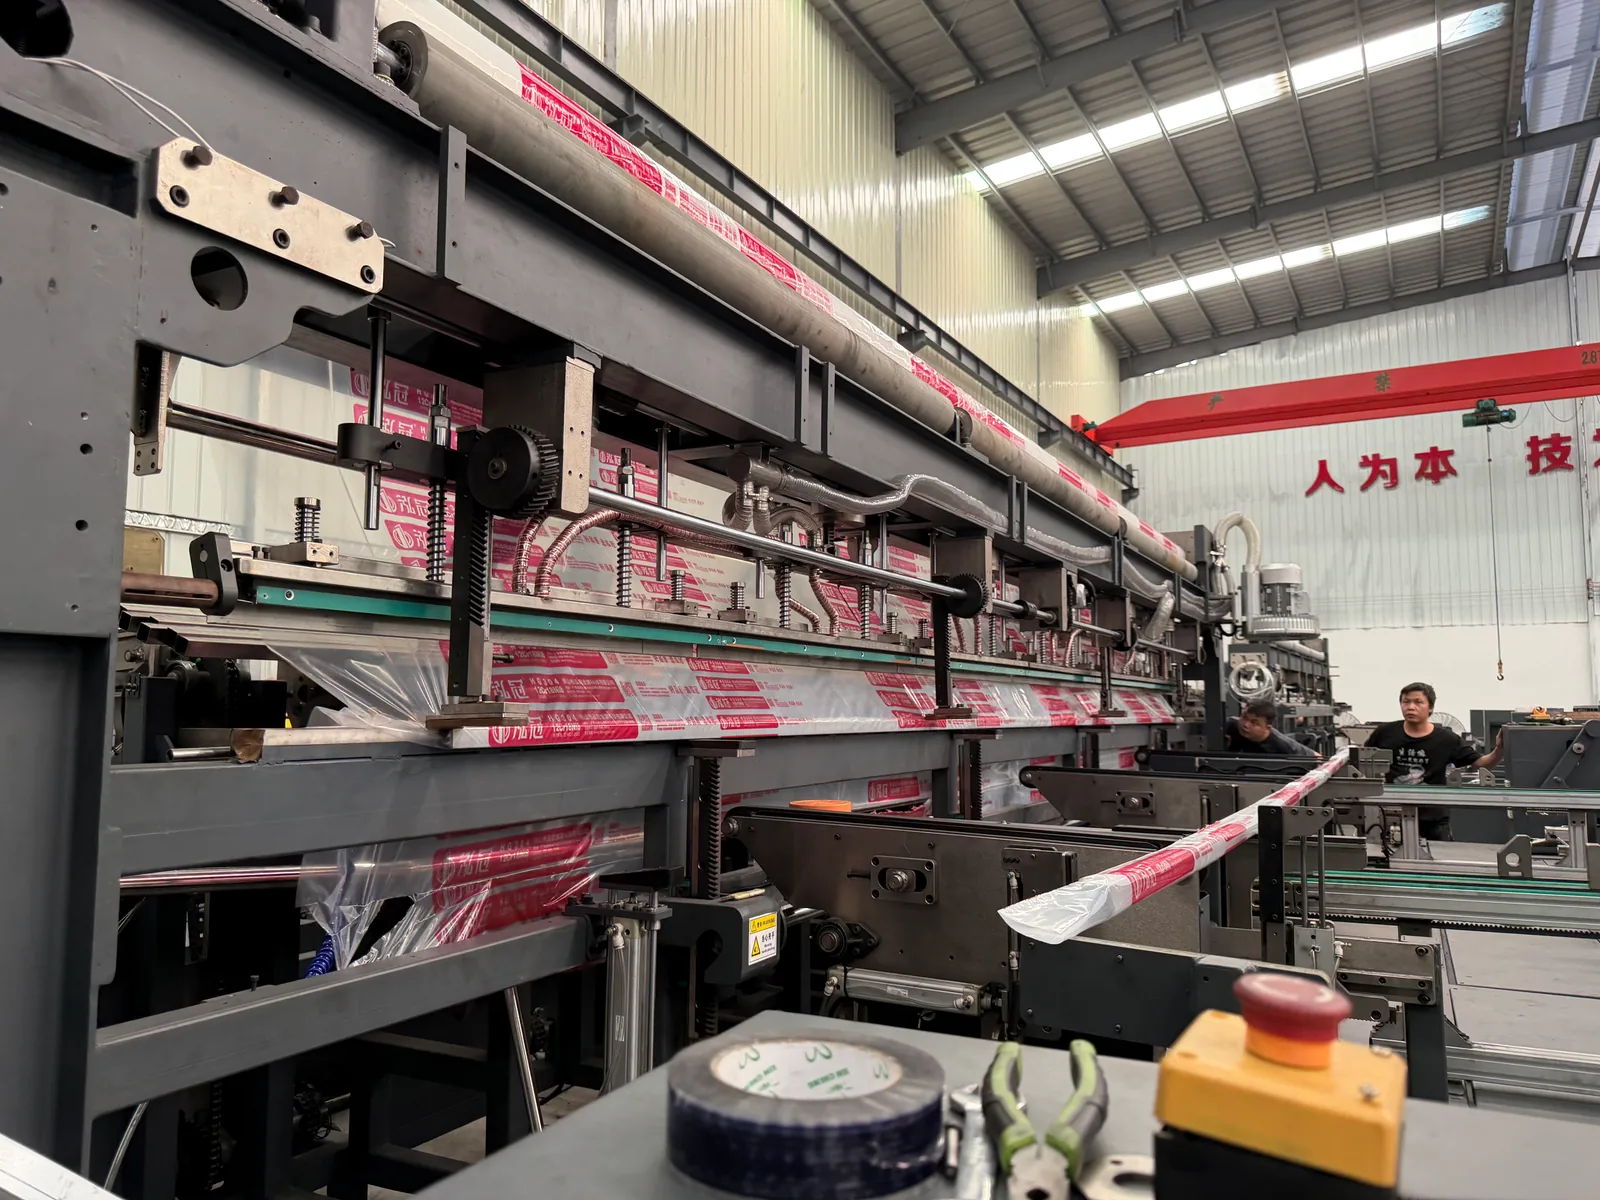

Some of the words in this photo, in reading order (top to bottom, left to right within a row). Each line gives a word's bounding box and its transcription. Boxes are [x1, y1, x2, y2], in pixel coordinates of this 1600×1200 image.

[1581, 350, 1600, 365] 2.8
[1305, 446, 1458, 498] 人为本
[1526, 428, 1600, 475] 技
